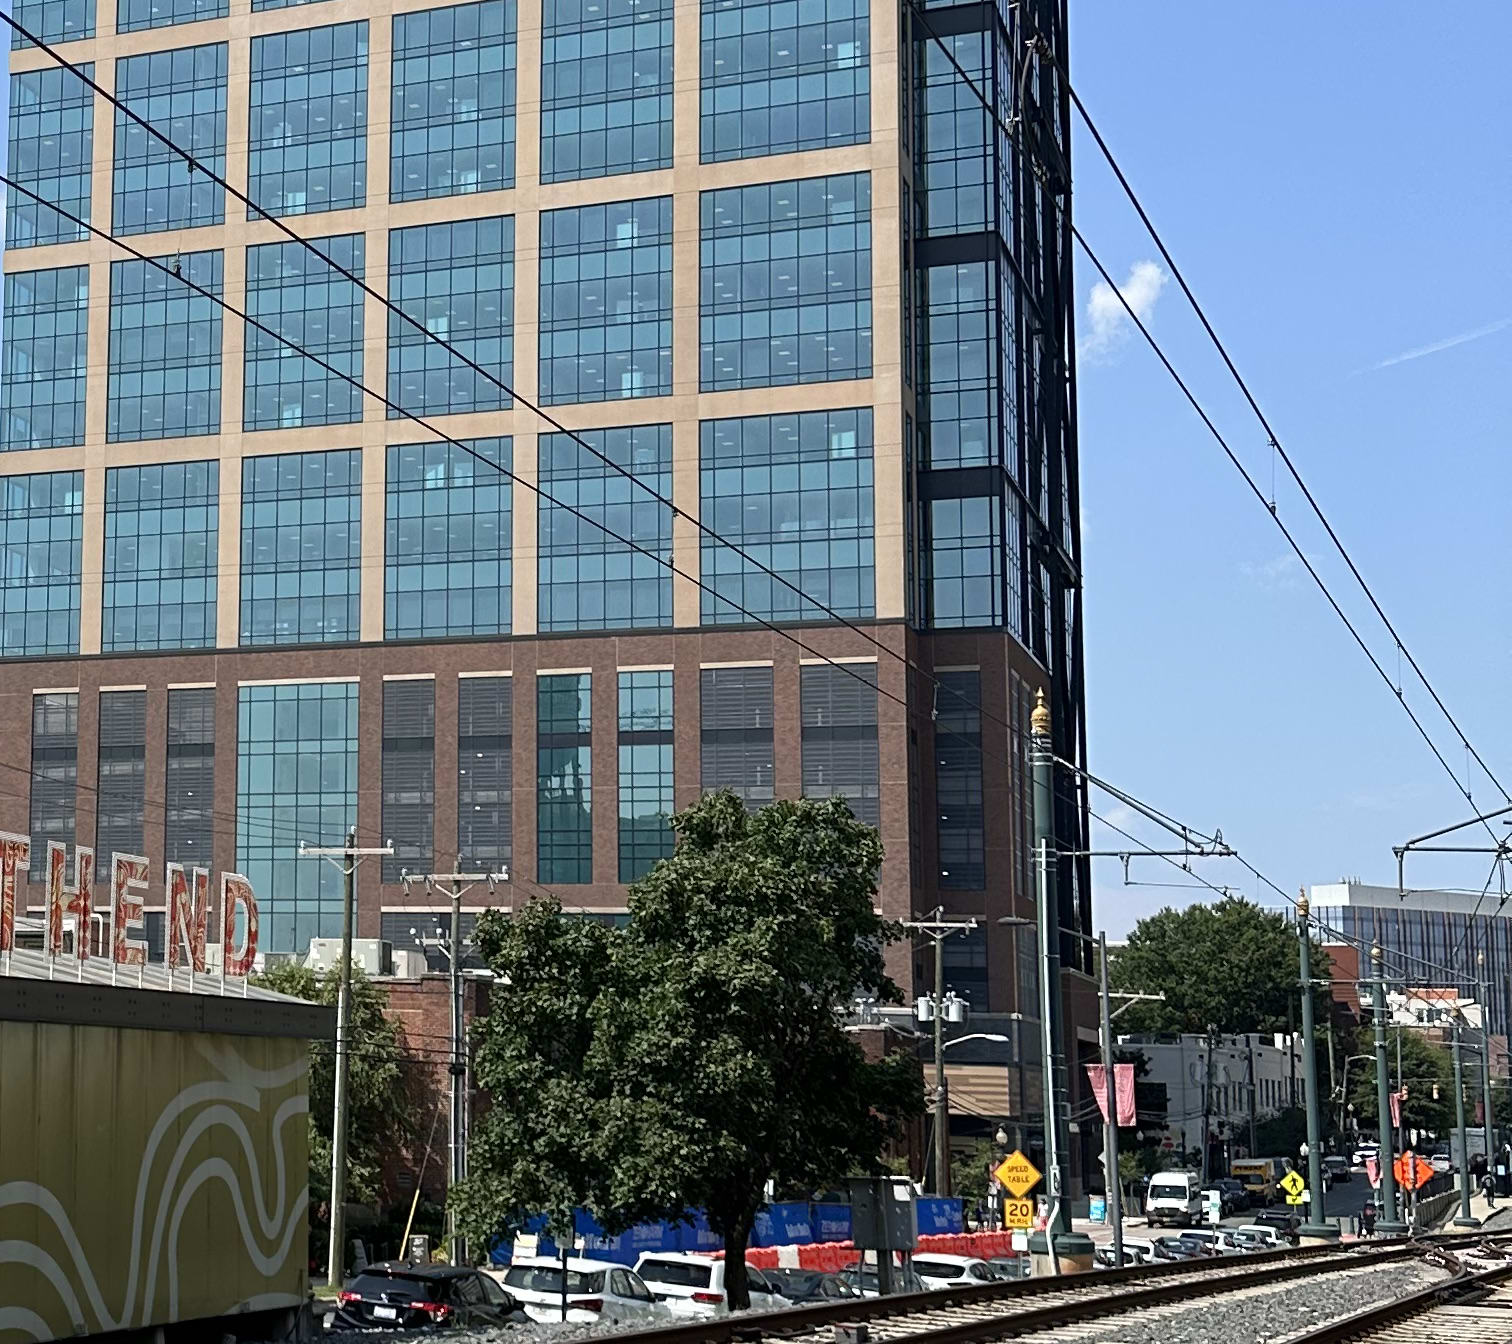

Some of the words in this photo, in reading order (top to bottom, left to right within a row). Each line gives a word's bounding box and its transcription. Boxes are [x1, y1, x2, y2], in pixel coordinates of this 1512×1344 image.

[1008, 1165, 1028, 1173] SPEED
[1008, 1175, 1030, 1183] TABLE
[1009, 1203, 1029, 1217] 20
